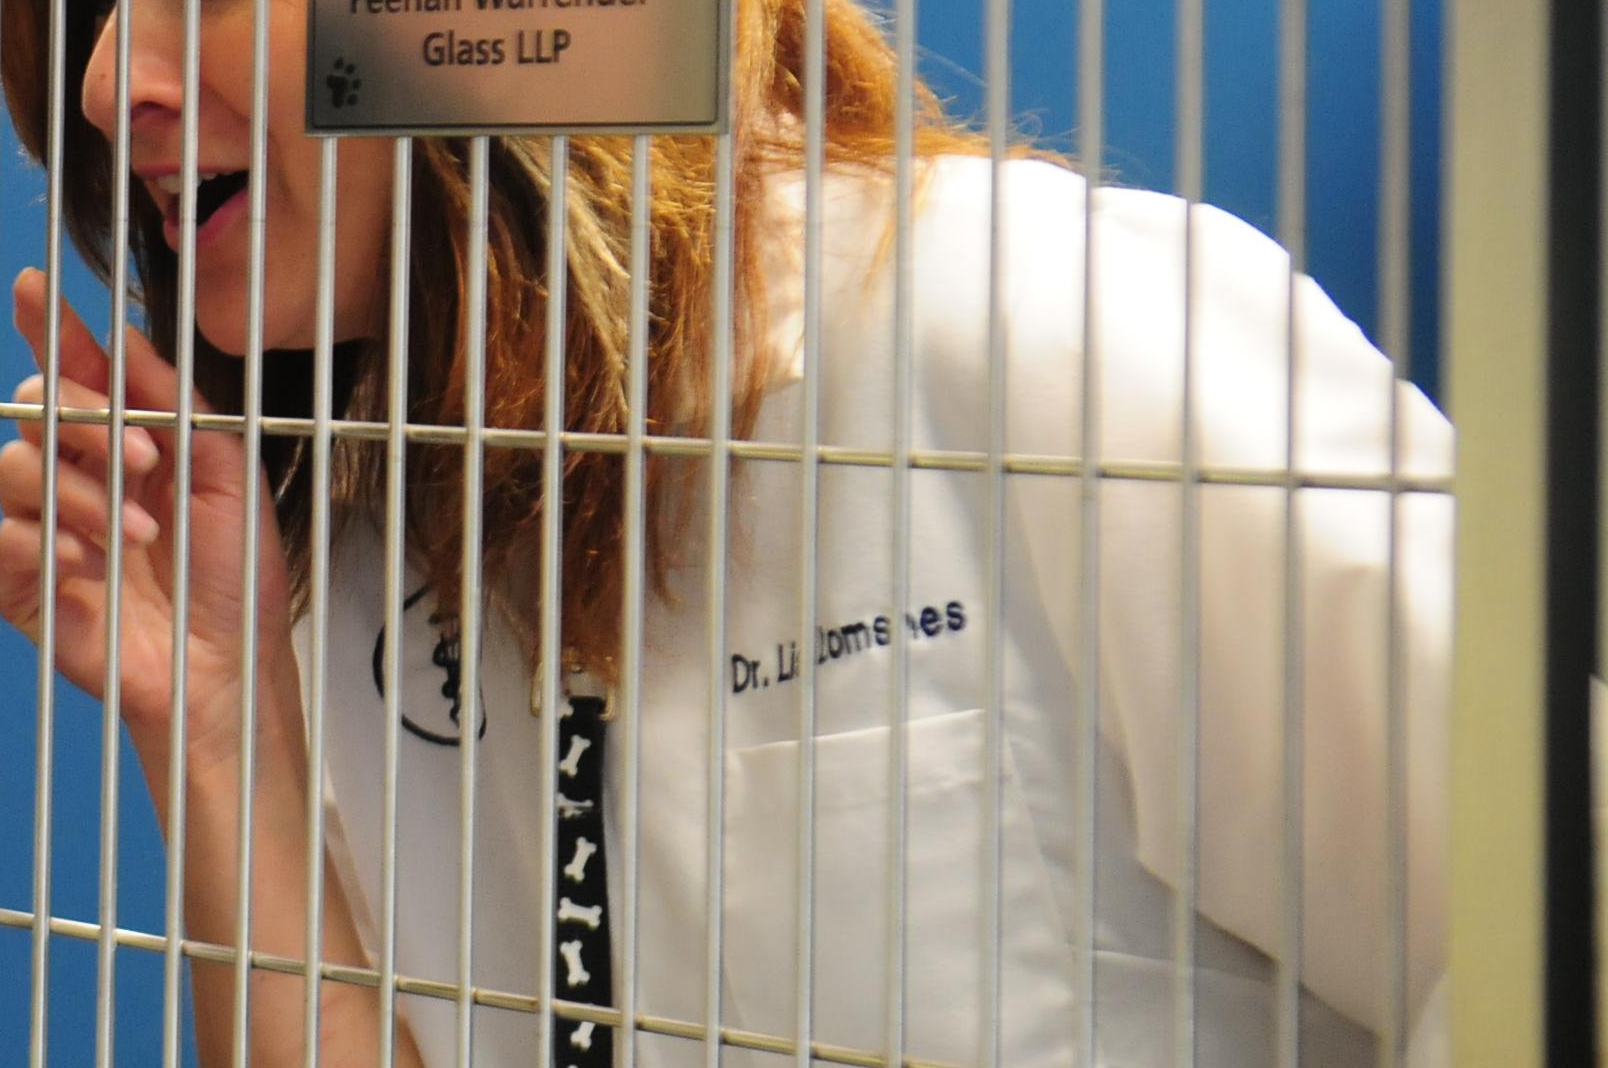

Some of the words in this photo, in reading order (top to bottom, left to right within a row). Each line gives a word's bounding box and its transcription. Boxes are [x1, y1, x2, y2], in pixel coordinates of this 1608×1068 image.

[422, 31, 506, 67] Glass
[516, 29, 572, 64] LLP
[731, 653, 769, 693] Dr.
